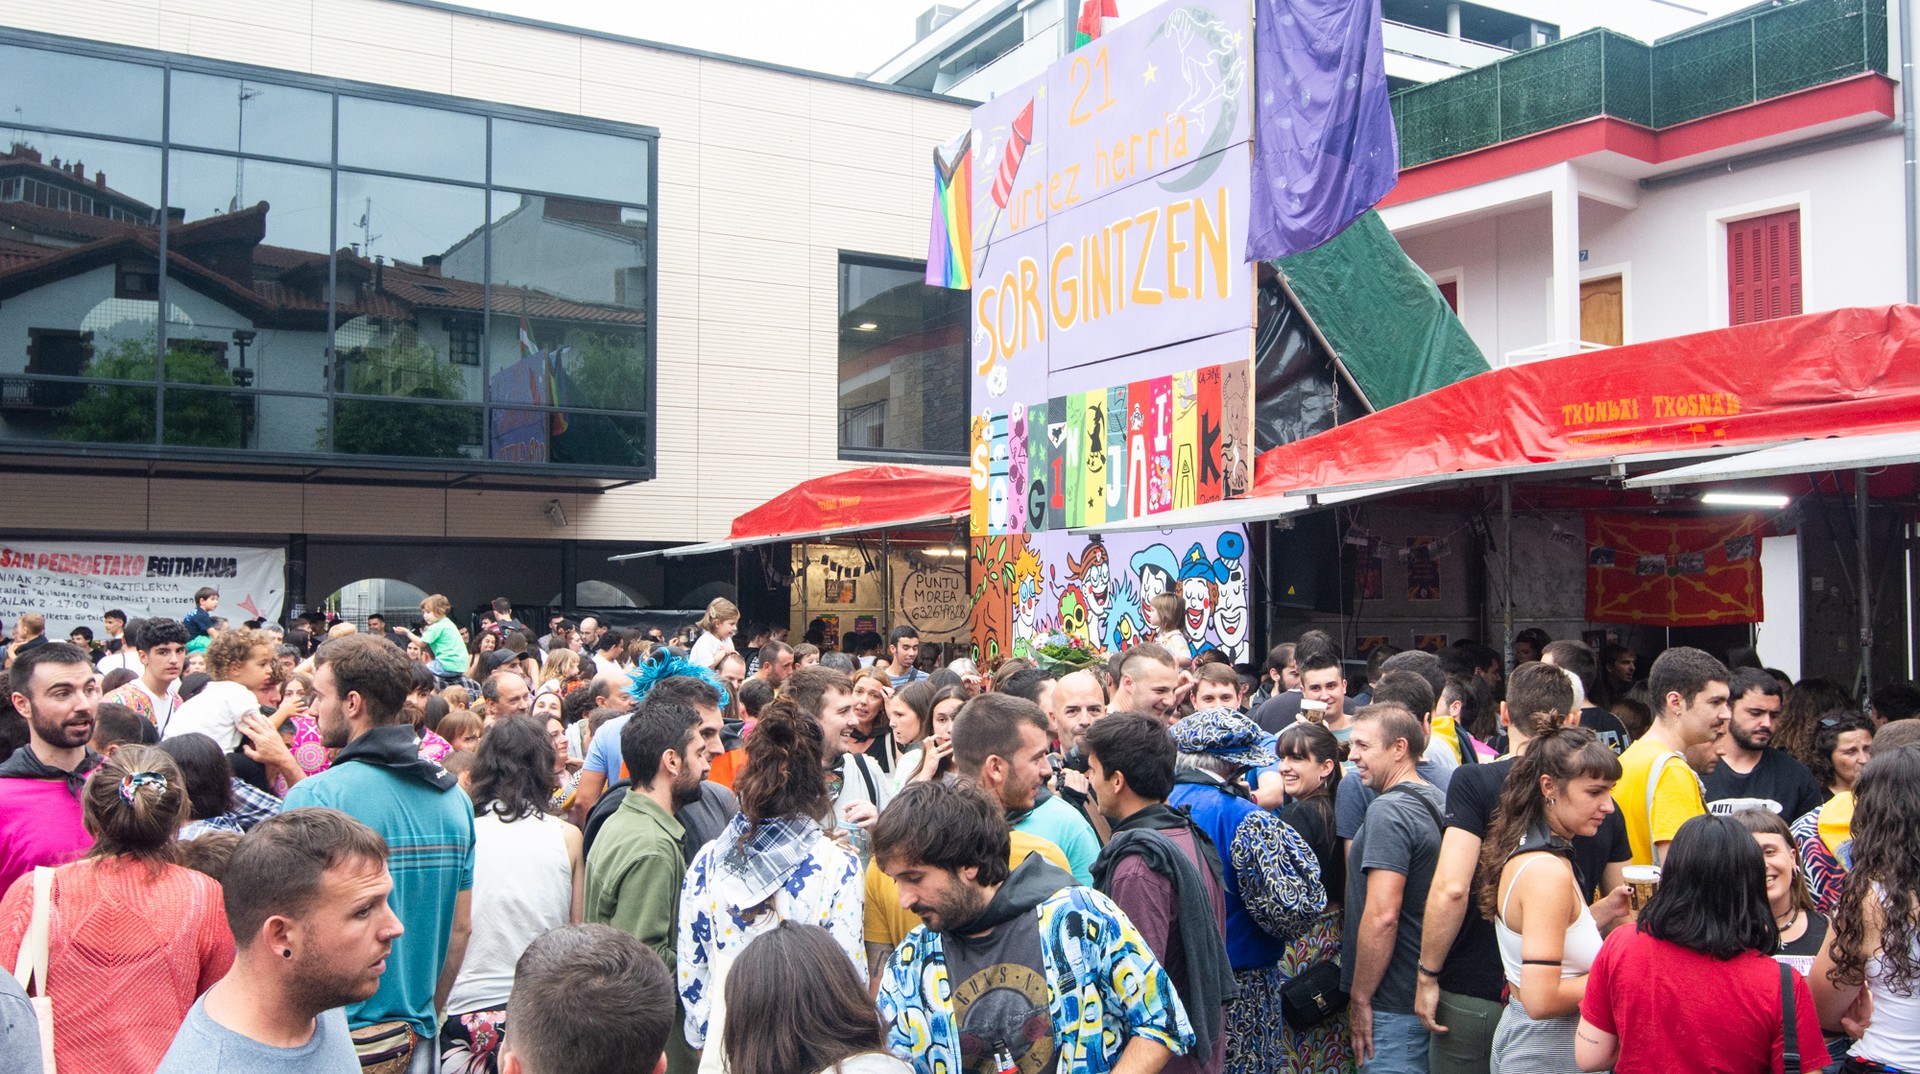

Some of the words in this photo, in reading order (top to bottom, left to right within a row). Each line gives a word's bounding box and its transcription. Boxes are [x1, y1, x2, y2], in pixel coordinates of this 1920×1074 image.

[1068, 43, 1117, 128] 21
[1008, 162, 1082, 232] urtez
[1094, 111, 1189, 190] herria
[0, 549, 35, 569] SAN
[37, 553, 145, 576] PEDROETAKO
[35, 576, 51, 586] 27
[103, 581, 179, 592] GAZTELEKUA
[916, 574, 959, 590] PUNTU
[0, 596, 35, 606] AILAK
[39, 599, 46, 607] 2
[914, 589, 957, 603] MOREA
